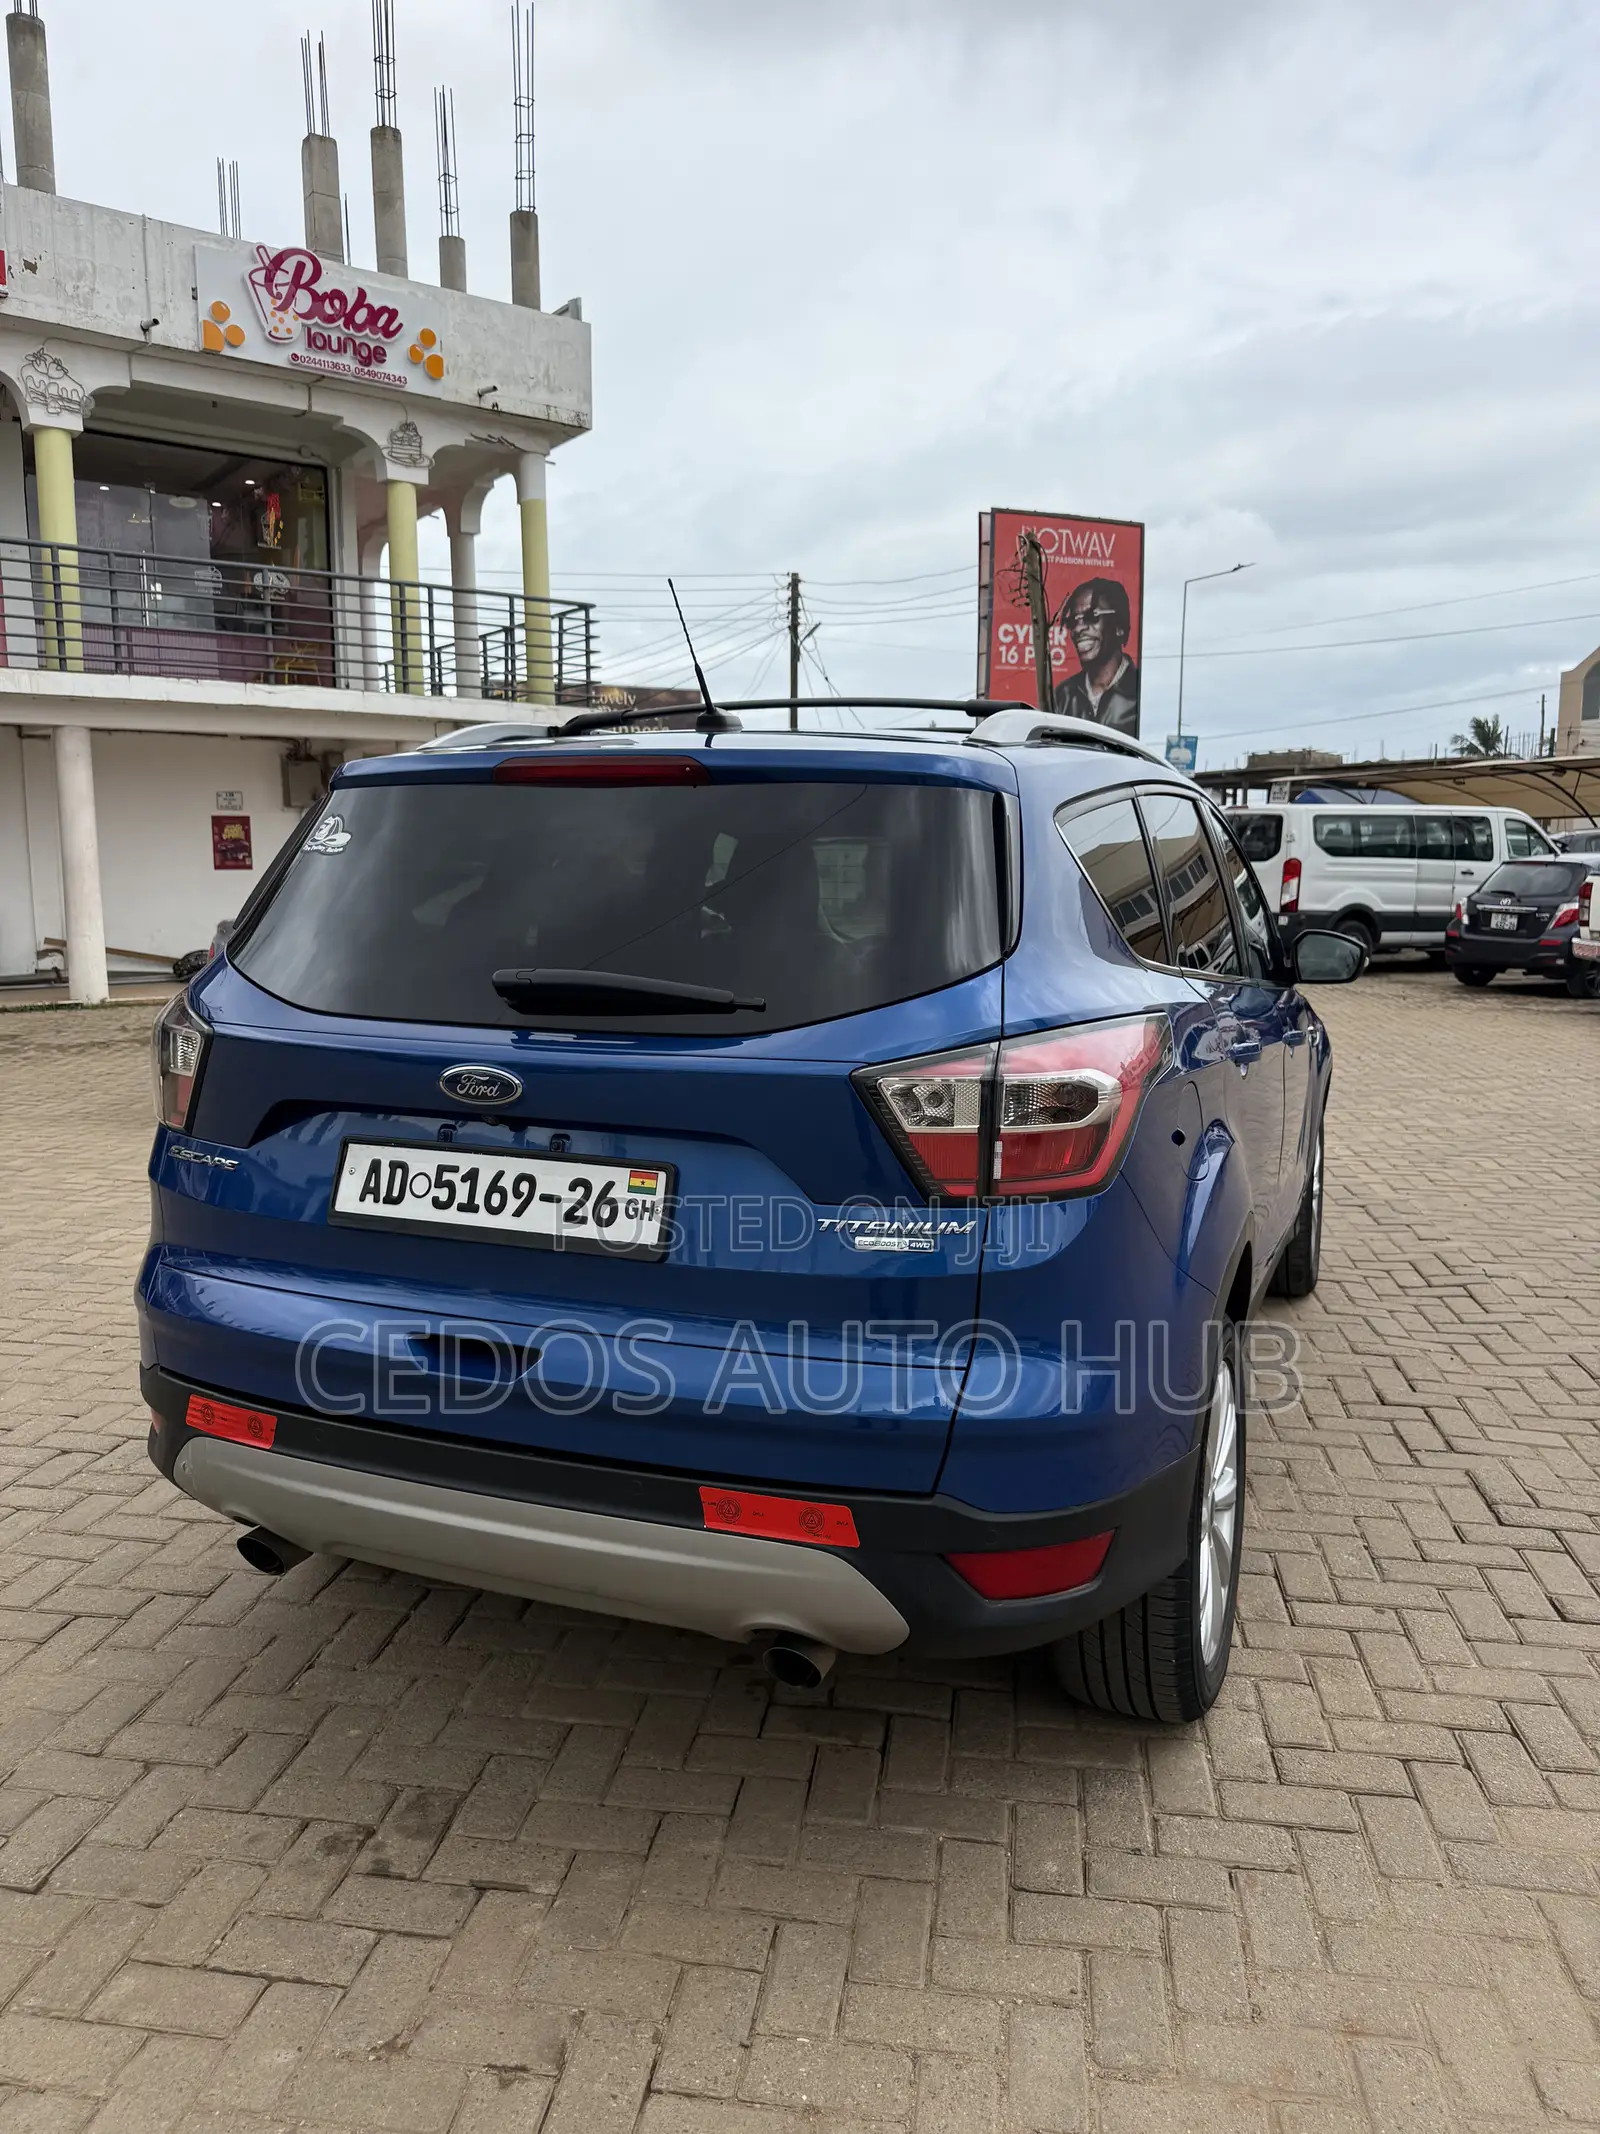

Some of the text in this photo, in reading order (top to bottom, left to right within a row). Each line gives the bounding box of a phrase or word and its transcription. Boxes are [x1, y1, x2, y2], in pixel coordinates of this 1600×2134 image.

[264, 247, 404, 339] Boba
[306, 327, 387, 367] lounge
[300, 355, 408, 385] 0244113633 0549074343
[1054, 555, 1084, 566] PASSION
[999, 645, 1067, 667] 16 PO
[592, 690, 637, 708] Lovely
[456, 1073, 502, 1098] Ford
[168, 1145, 240, 1172] ESCAPE
[359, 1158, 620, 1228] AD 5169-26
[625, 1197, 656, 1222] GH
[817, 1218, 977, 1235] TITANIUM
[909, 1241, 931, 1250] 4WD
